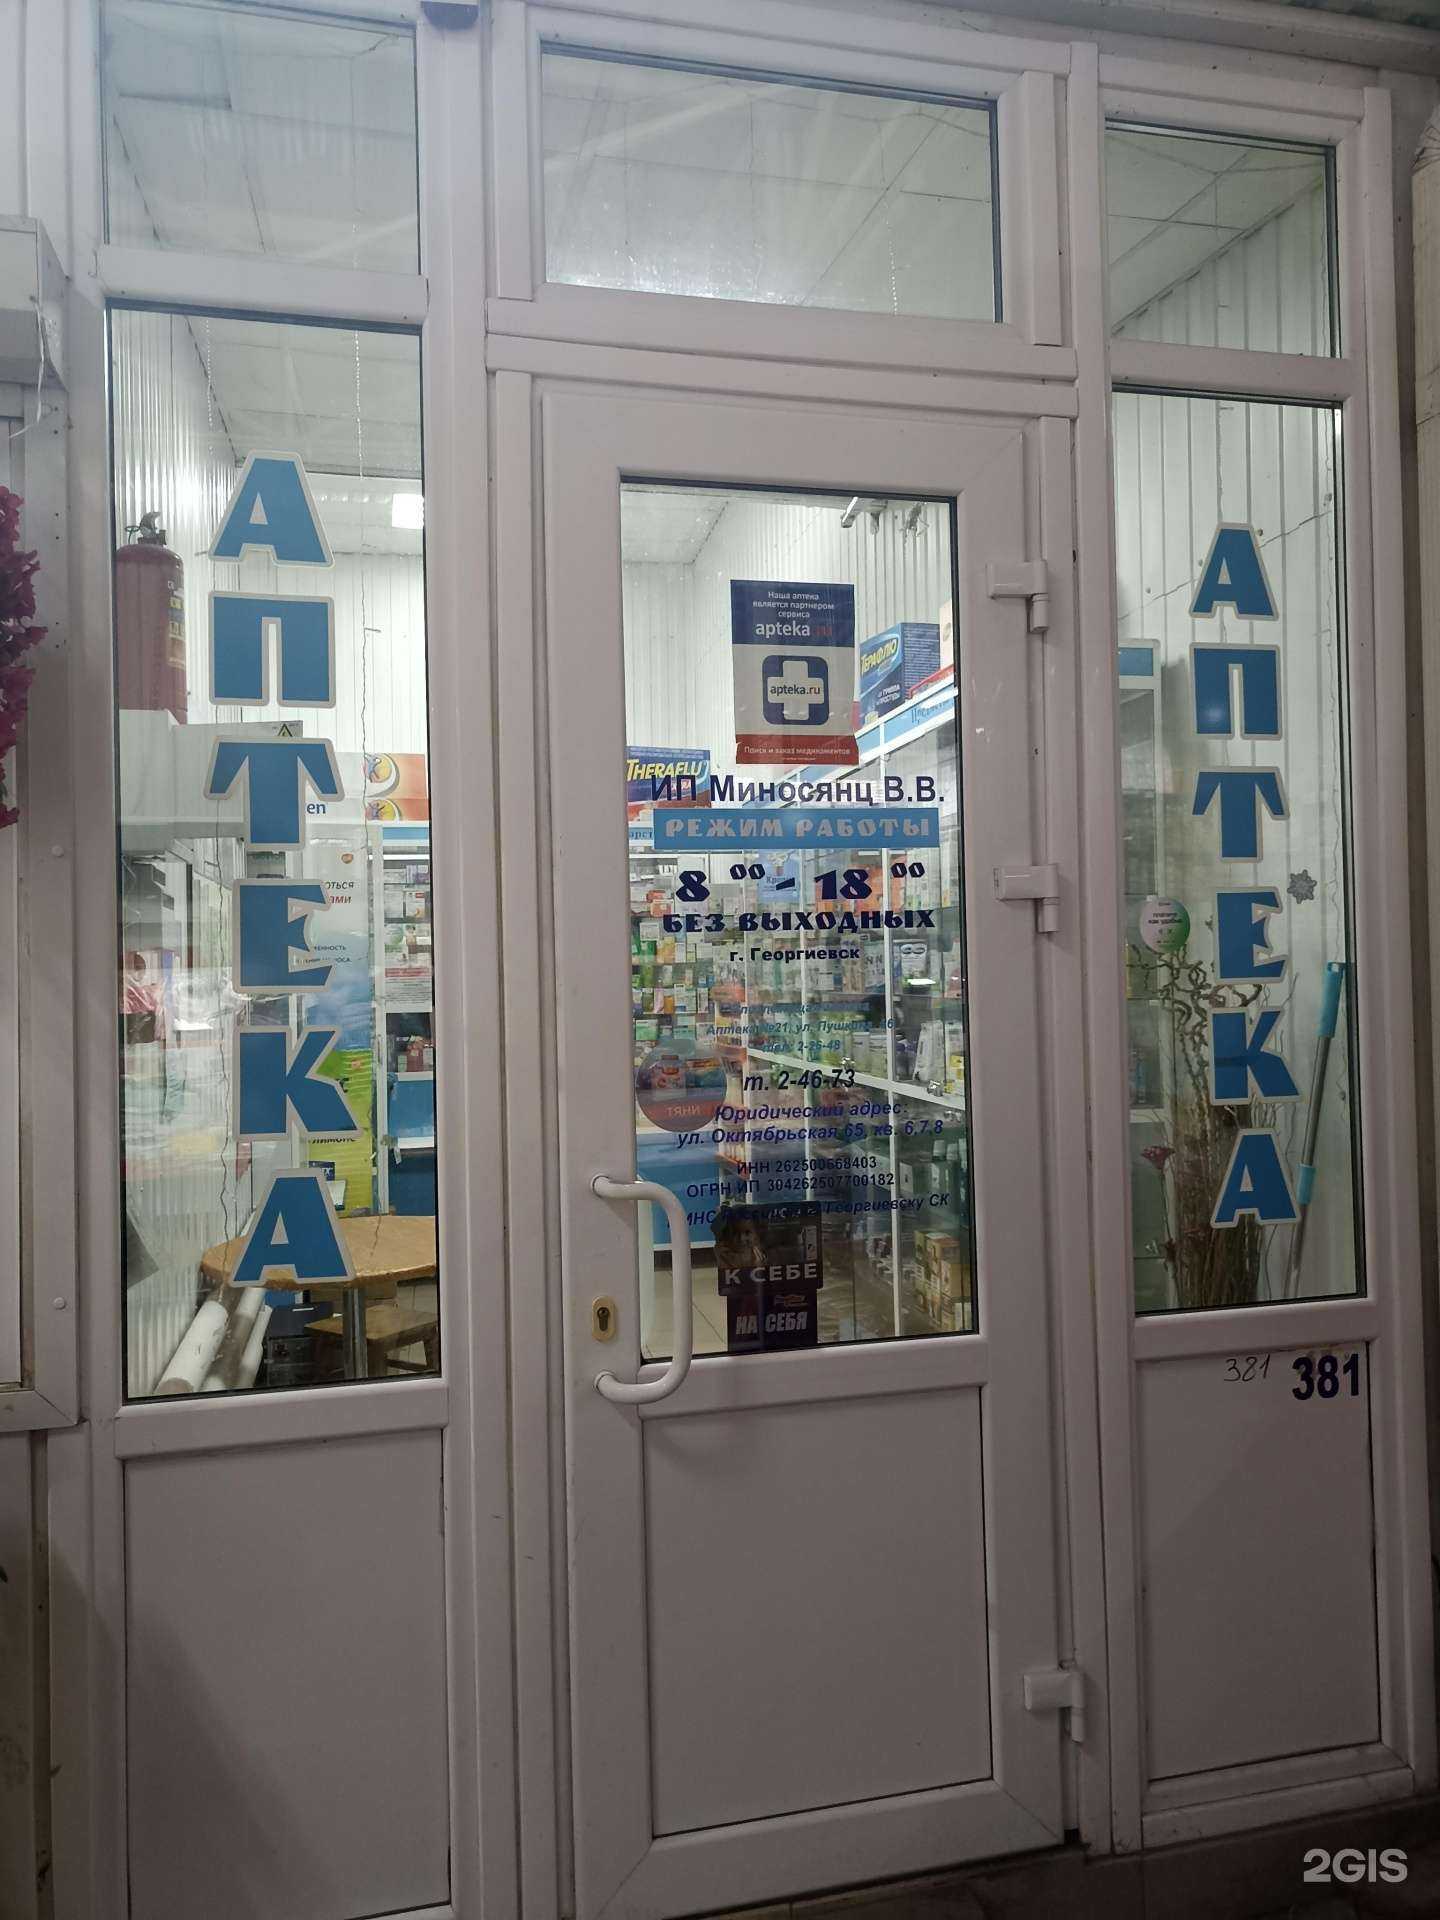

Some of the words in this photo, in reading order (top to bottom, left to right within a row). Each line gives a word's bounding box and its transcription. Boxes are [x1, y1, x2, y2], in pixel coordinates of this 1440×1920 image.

[753, 601, 788, 609] является
[790, 602, 835, 611] партнером
[768, 591, 790, 600] Наша
[792, 593, 819, 602] аптека
[770, 684, 820, 696] apteka.ru
[627, 759, 701, 781] THERAFLU
[651, 775, 697, 802] ИП
[710, 775, 873, 806] Миносянц
[884, 775, 944, 803] В.В.
[665, 818, 783, 838] РЕЖИМ
[795, 818, 929, 837] РАБОТЫ
[204, 452, 361, 1287] АПТЕКА
[1189, 523, 1299, 1228] АПТЕКА
[676, 870, 710, 902] 8
[730, 863, 765, 880] 00
[814, 868, 872, 900] 18
[891, 862, 925, 878] 00
[663, 913, 726, 933] БЕЗ
[738, 909, 936, 934] ВЫХОДНЫХ
[729, 950, 744, 962] г.
[750, 947, 860, 964] Георгиевск
[778, 1068, 855, 1090] 2-46-73
[714, 1104, 844, 1123] Юридический
[677, 1130, 704, 1148] ул.
[711, 1124, 837, 1145] Октябрьская
[737, 1159, 770, 1175] ИНН
[687, 1181, 732, 1197] ОГРН
[736, 1177, 761, 1193] ИП
[929, 1193, 951, 1207] СК
[725, 1268, 742, 1284] К
[749, 1263, 818, 1282] СЕБЕ
[735, 1312, 758, 1335] НА
[765, 1311, 808, 1333] СЕБЯ
[1223, 1353, 1270, 1382] 381
[1292, 1353, 1359, 1400] 381
